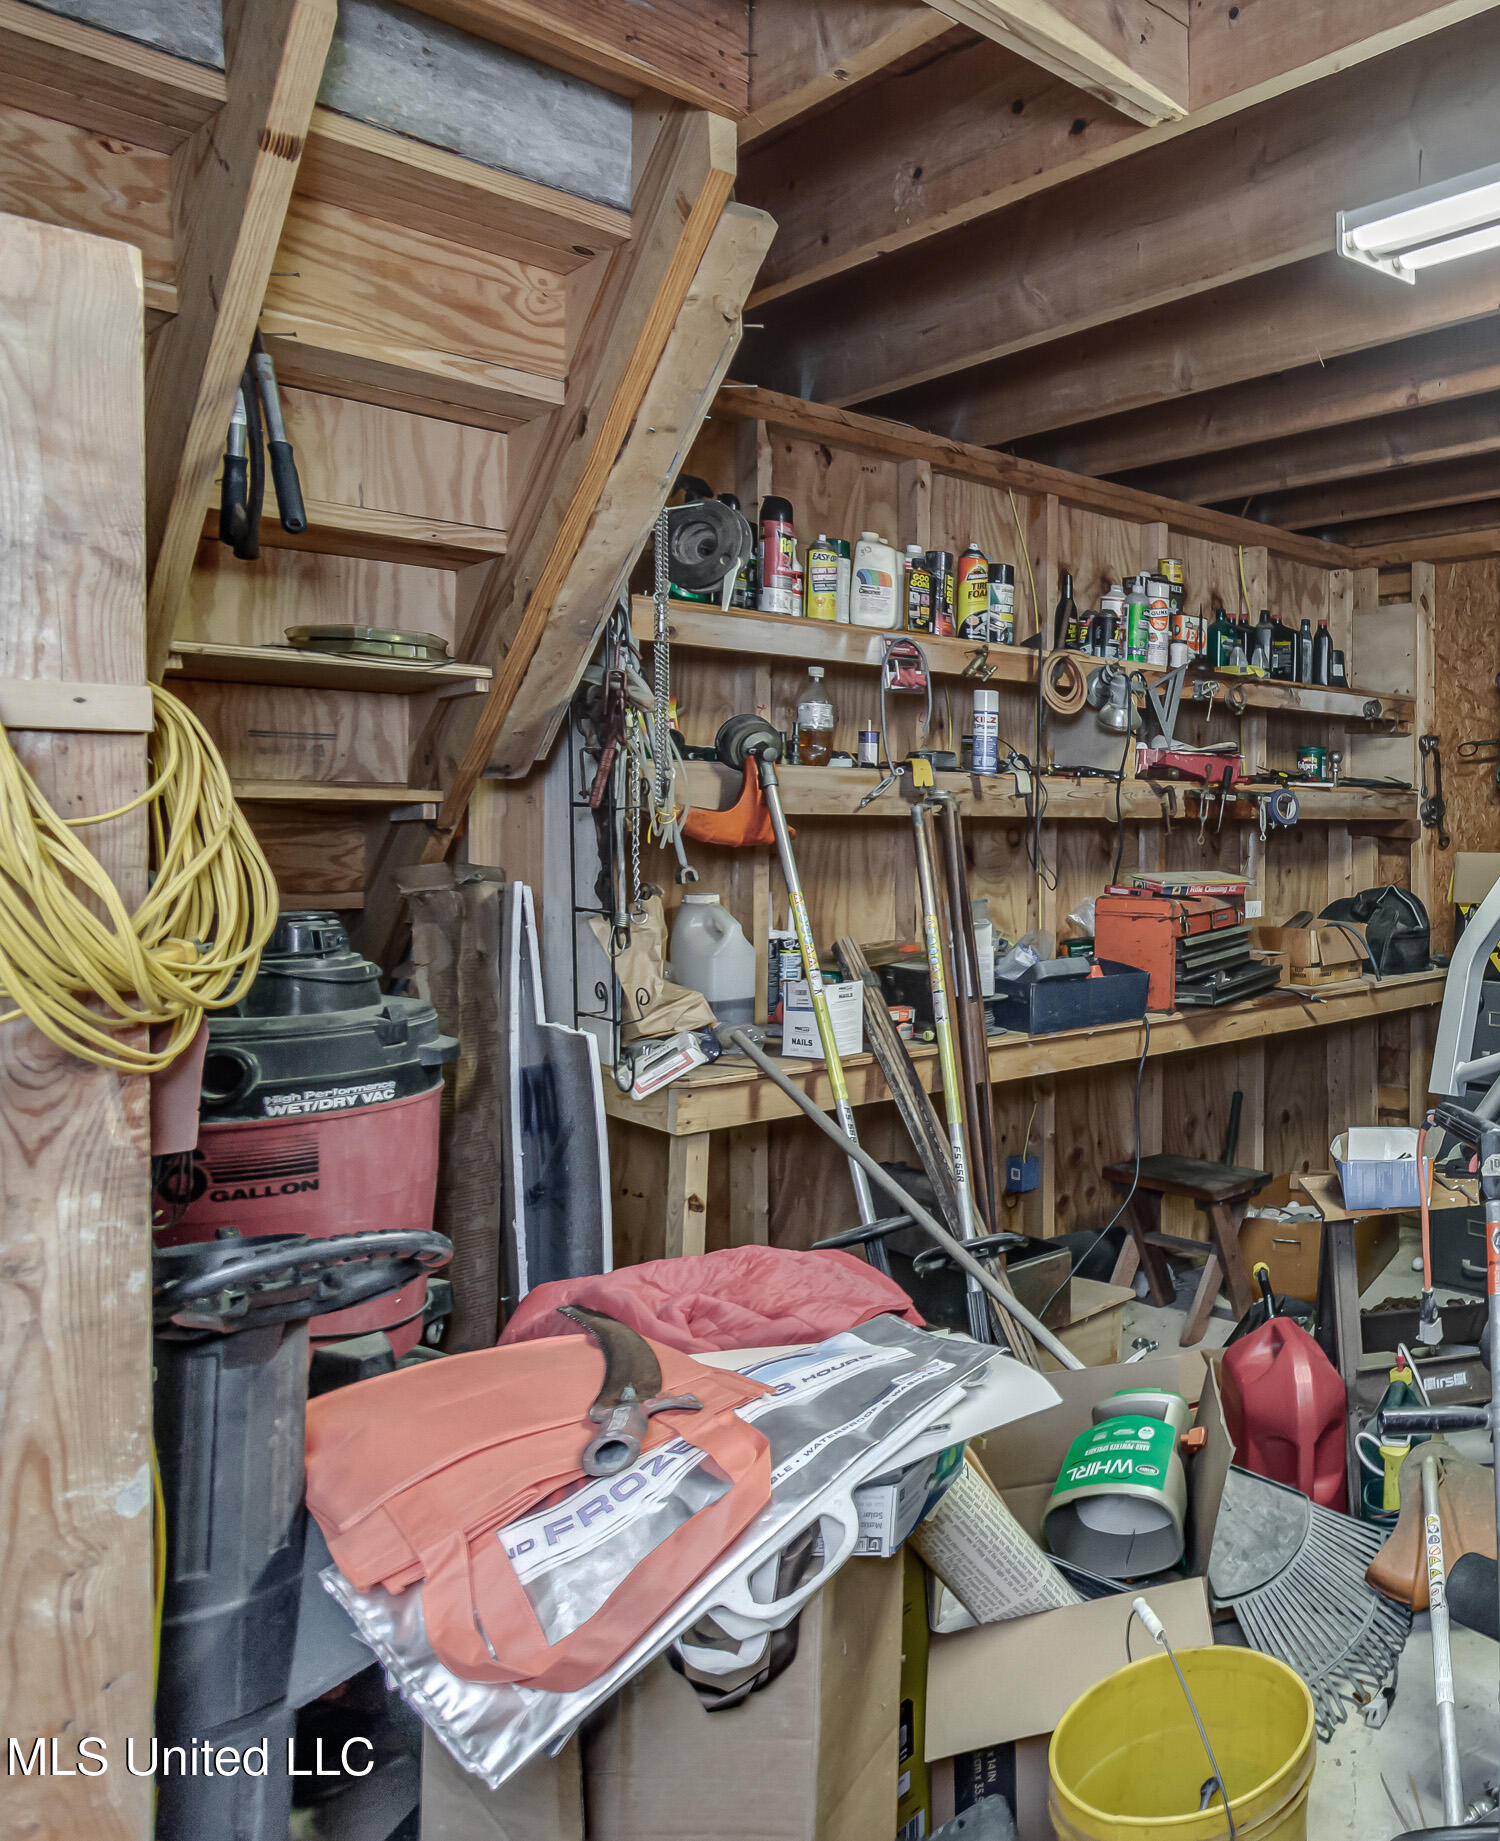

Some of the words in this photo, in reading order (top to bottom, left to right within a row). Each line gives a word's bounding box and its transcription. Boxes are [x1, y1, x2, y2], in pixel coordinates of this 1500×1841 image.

[791, 1037, 813, 1046] NAILS
[263, 1093, 302, 1106] High
[303, 1080, 396, 1100] Performance
[265, 1094, 358, 1117] WET/DRY
[361, 1089, 396, 1105] VAC
[209, 1178, 319, 1203] GALLON
[801, 1354, 873, 1383] HOURS
[803, 1405, 879, 1456] WATERPROOF
[891, 1366, 947, 1397] WASHABLE
[1066, 1459, 1134, 1481] WHIRL
